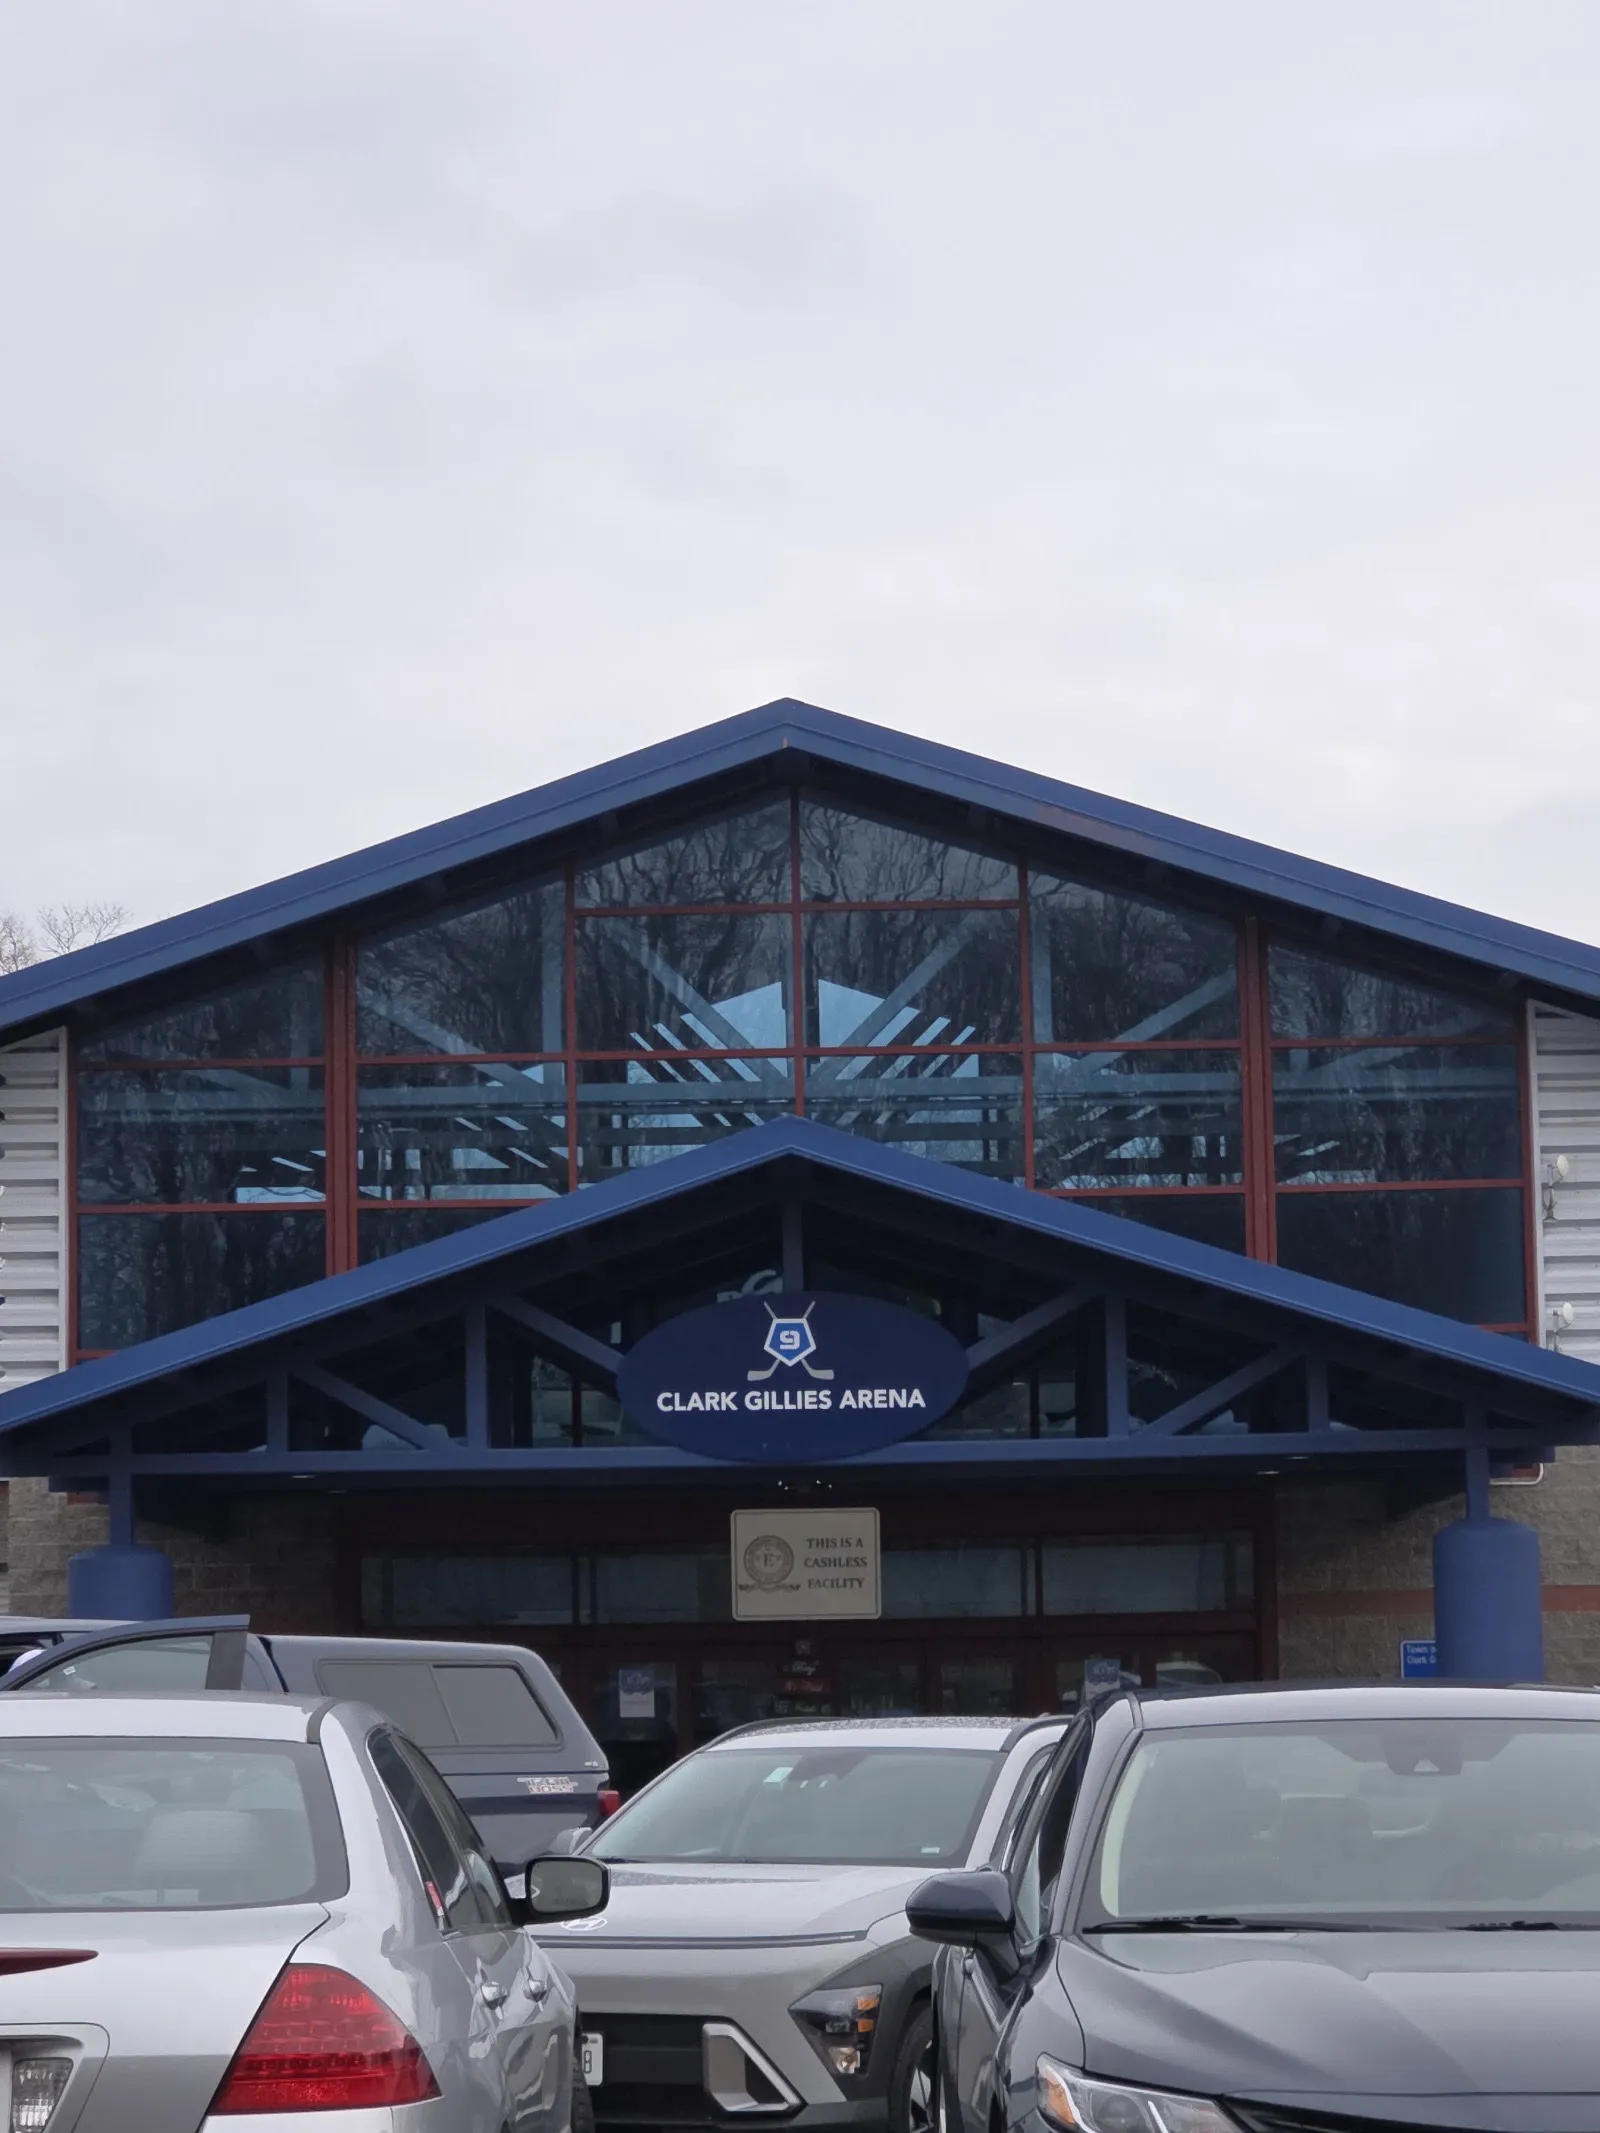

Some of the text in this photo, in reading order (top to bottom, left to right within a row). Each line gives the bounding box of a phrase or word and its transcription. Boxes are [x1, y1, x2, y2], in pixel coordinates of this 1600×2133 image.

[779, 1330, 800, 1350] 9
[657, 1388, 926, 1412] CLARK GILLIES ARENA
[806, 1537, 864, 1549] THIS IS A
[804, 1557, 867, 1568] CASHLESS
[807, 1577, 865, 1589] FACILITY
